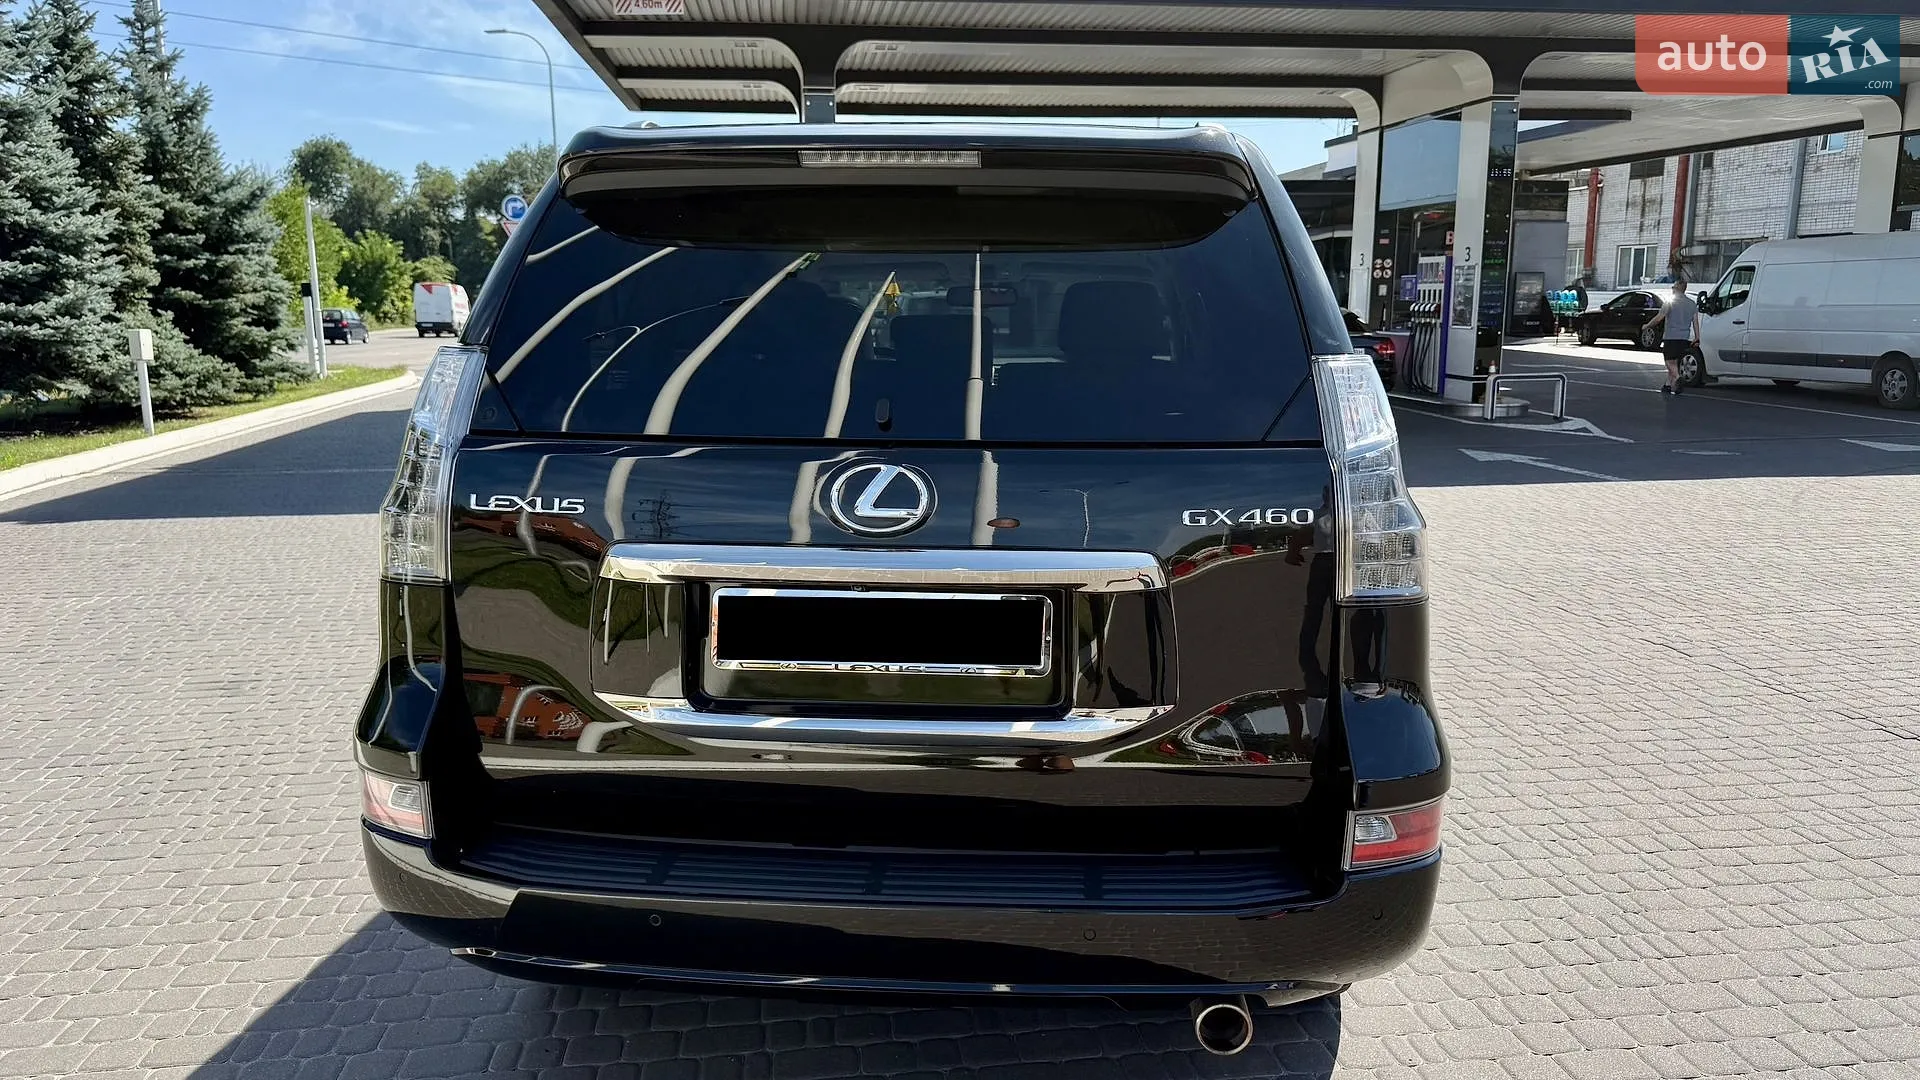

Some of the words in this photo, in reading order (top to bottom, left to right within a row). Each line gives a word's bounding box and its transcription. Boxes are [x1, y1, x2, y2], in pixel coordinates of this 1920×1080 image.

[635, 0, 662, 8] 4.60m
[1359, 253, 1365, 266] 3
[1464, 246, 1471, 262] 3
[469, 493, 586, 514] LEXUS
[835, 663, 922, 673] LEXUS
